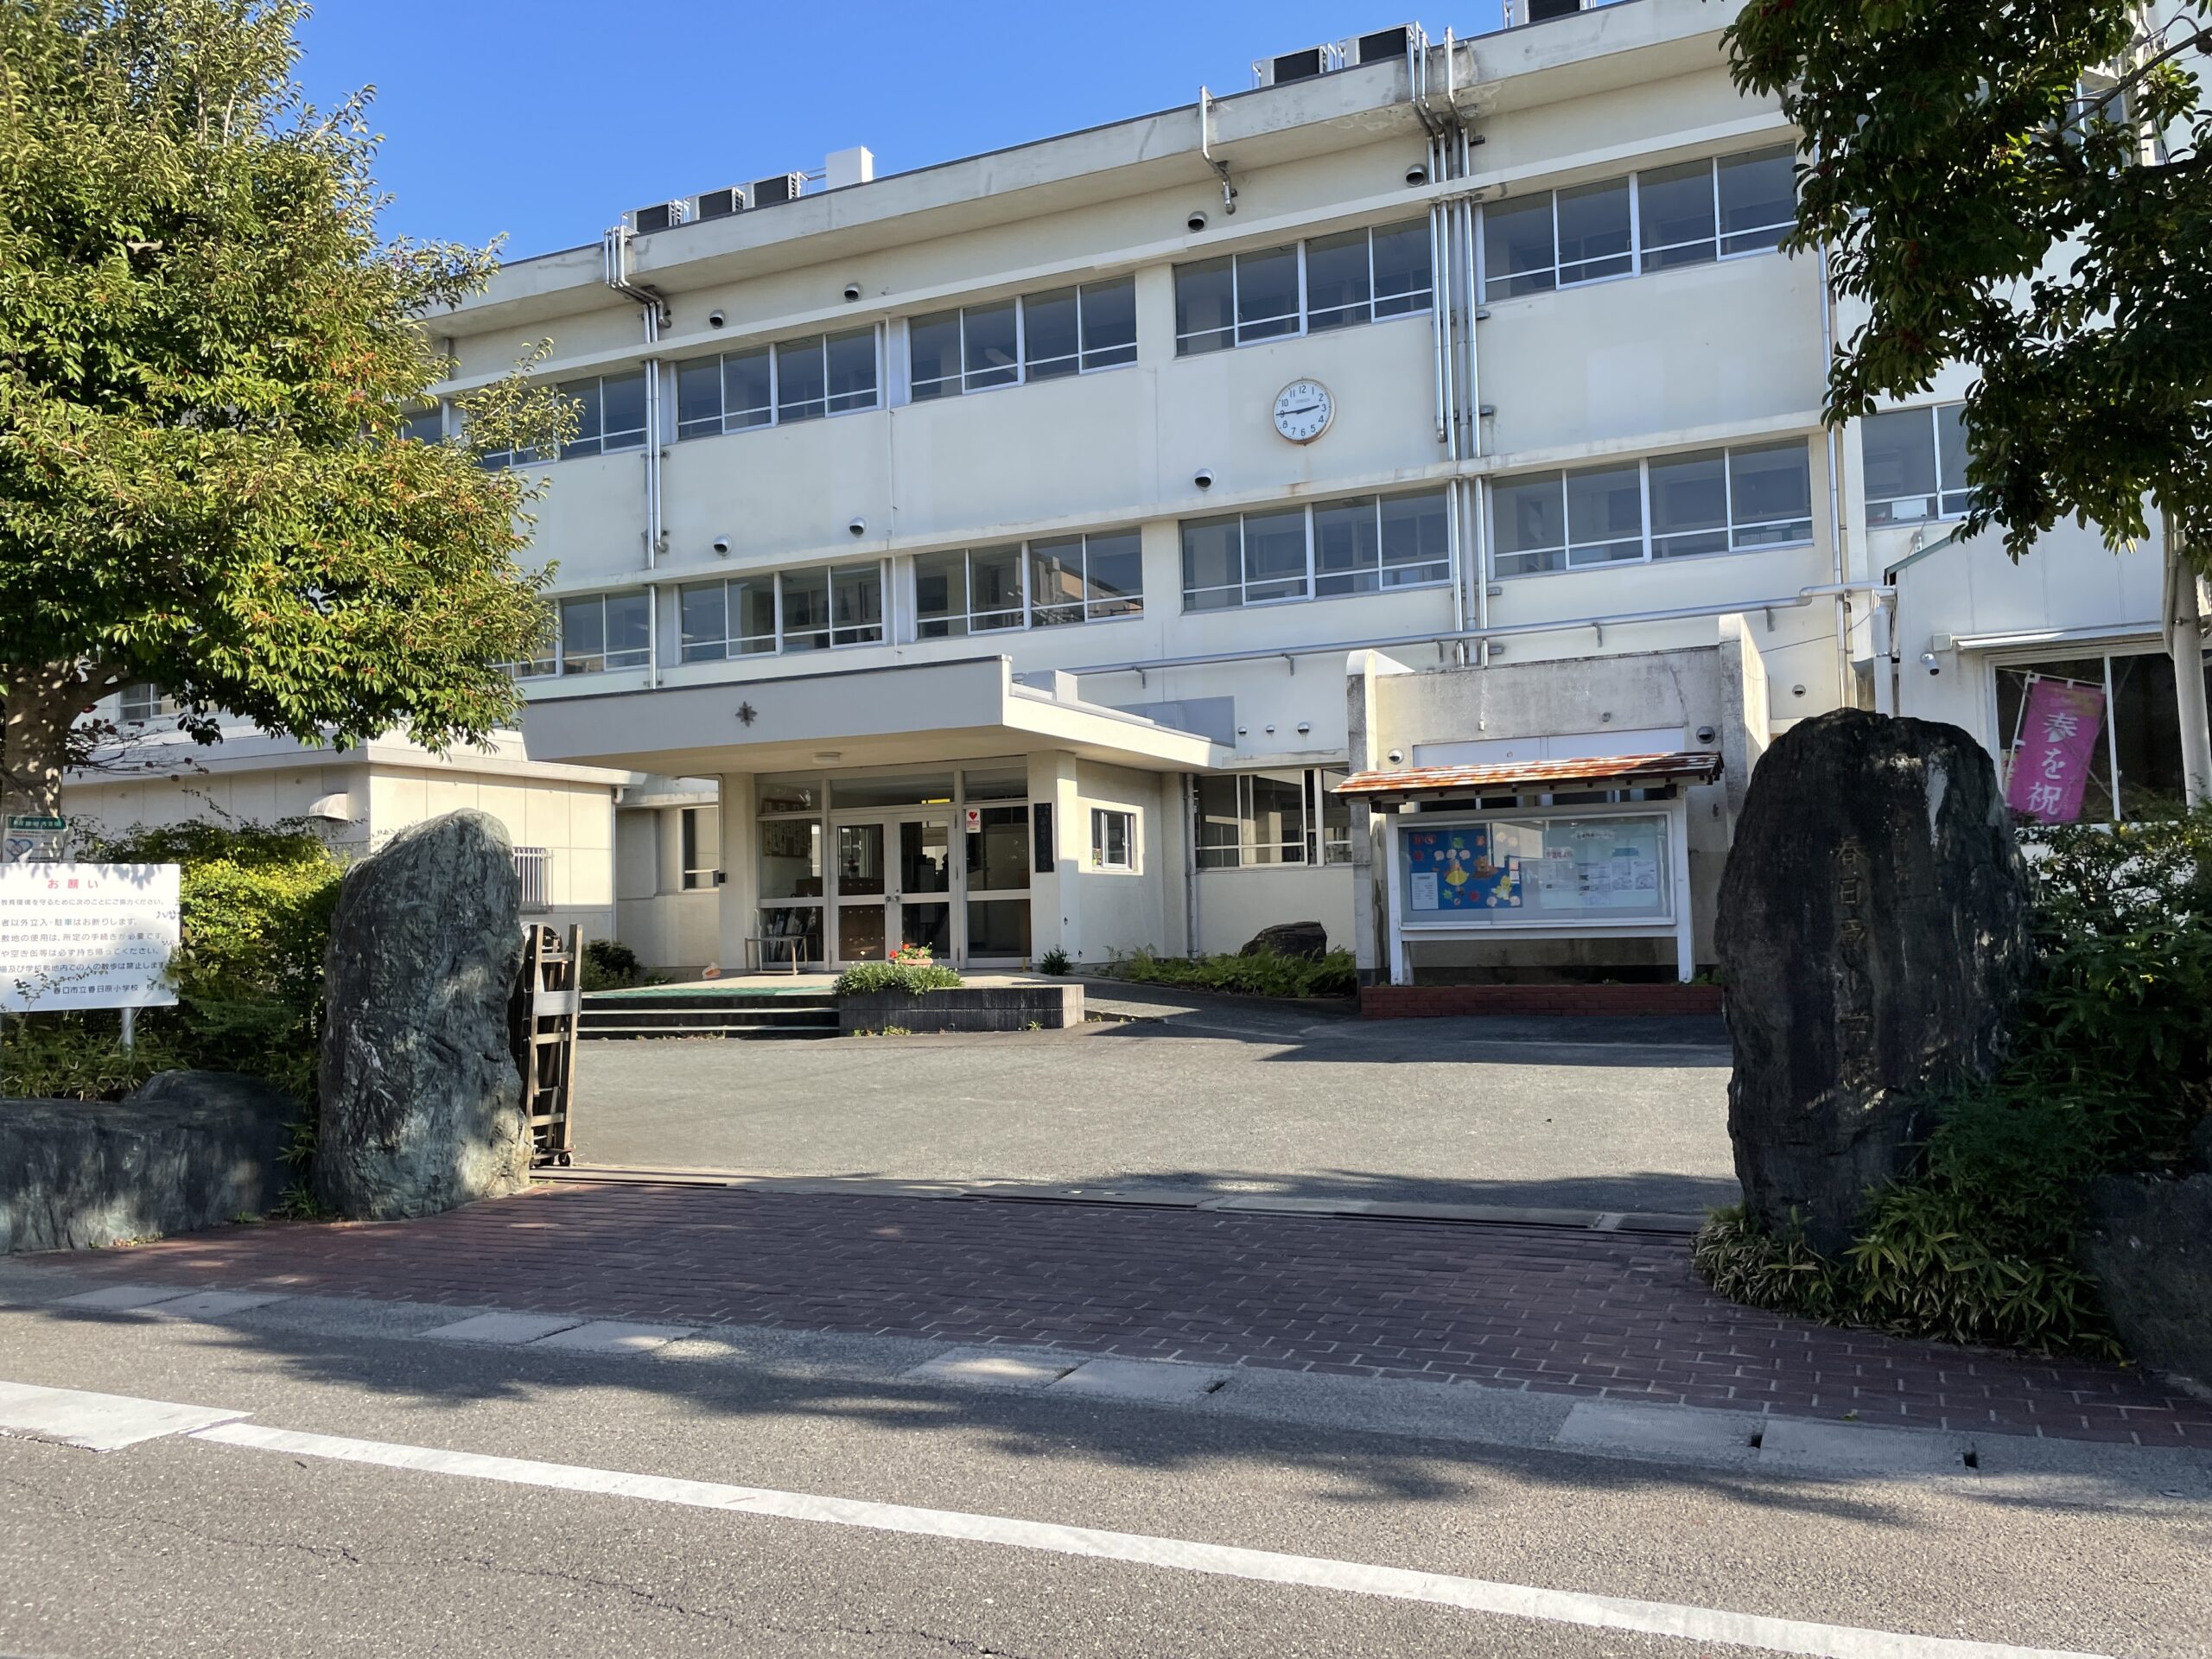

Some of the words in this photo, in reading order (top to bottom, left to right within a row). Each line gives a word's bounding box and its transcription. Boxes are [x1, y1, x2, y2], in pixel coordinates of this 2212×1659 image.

[1300, 385, 1306, 394] 12
[1280, 410, 1285, 418] 9
[1291, 427, 1296, 435] 7
